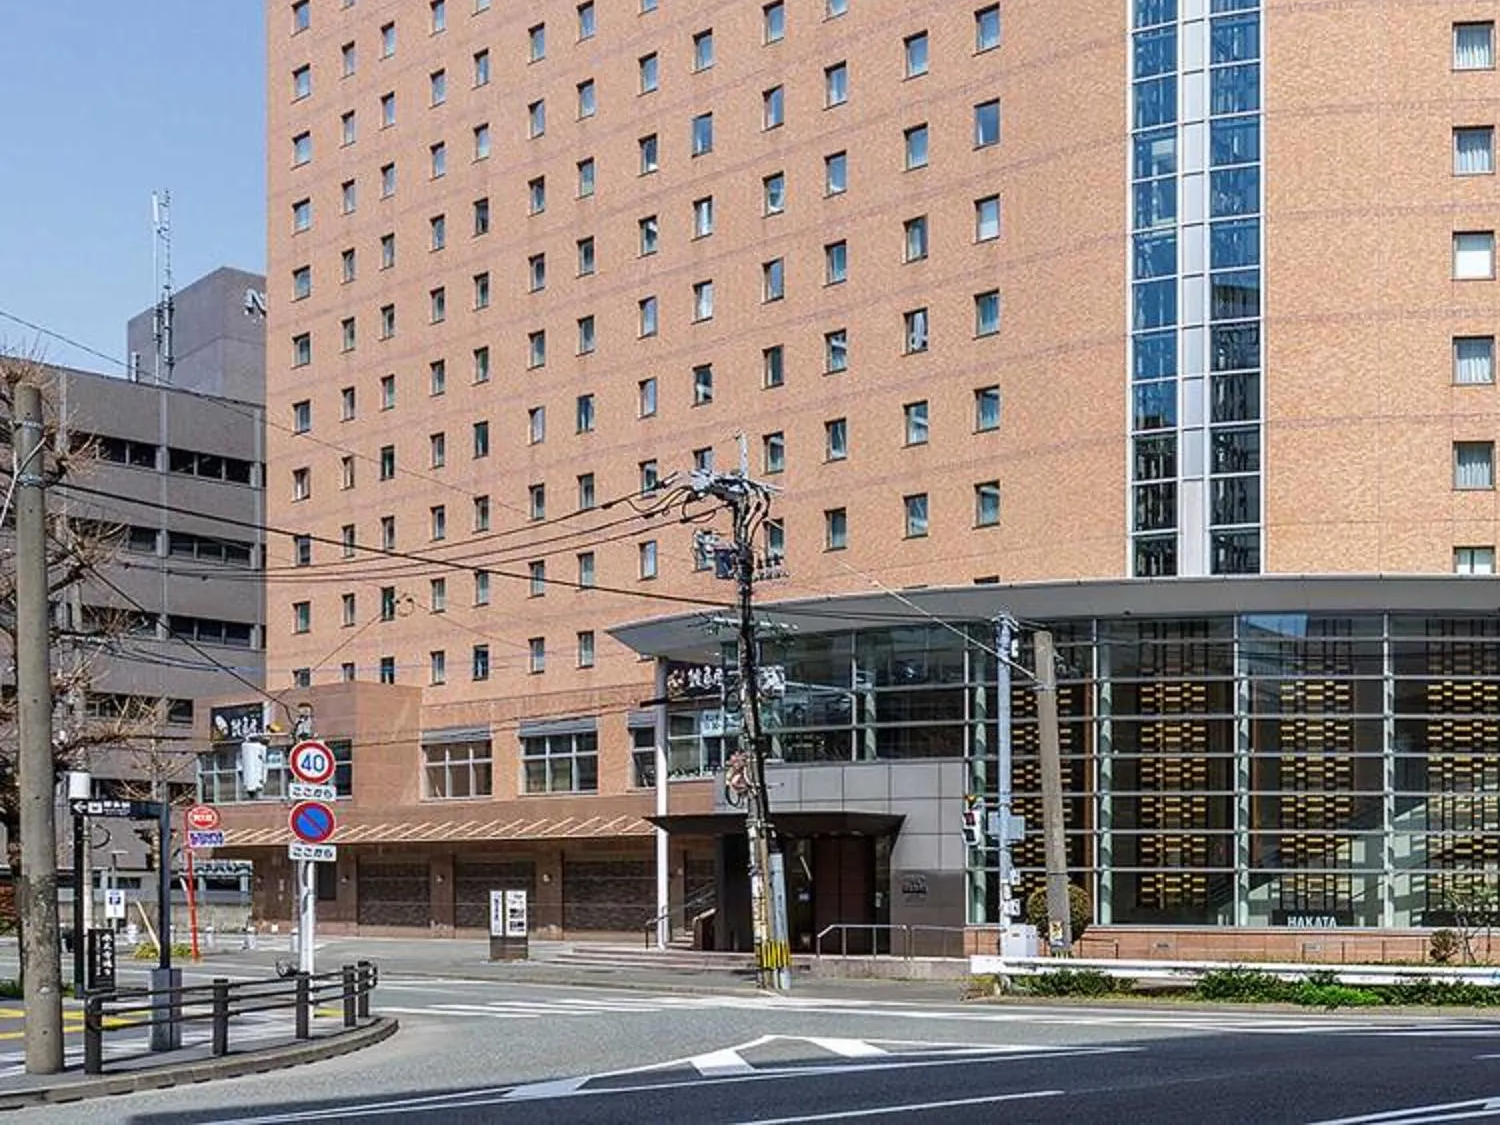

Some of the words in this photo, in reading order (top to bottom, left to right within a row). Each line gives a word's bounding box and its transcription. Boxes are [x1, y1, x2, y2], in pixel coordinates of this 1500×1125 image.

[301, 753, 325, 772] 40
[292, 786, 334, 798] ここから
[292, 846, 334, 859] ここから
[1286, 915, 1337, 929] HAKATA
